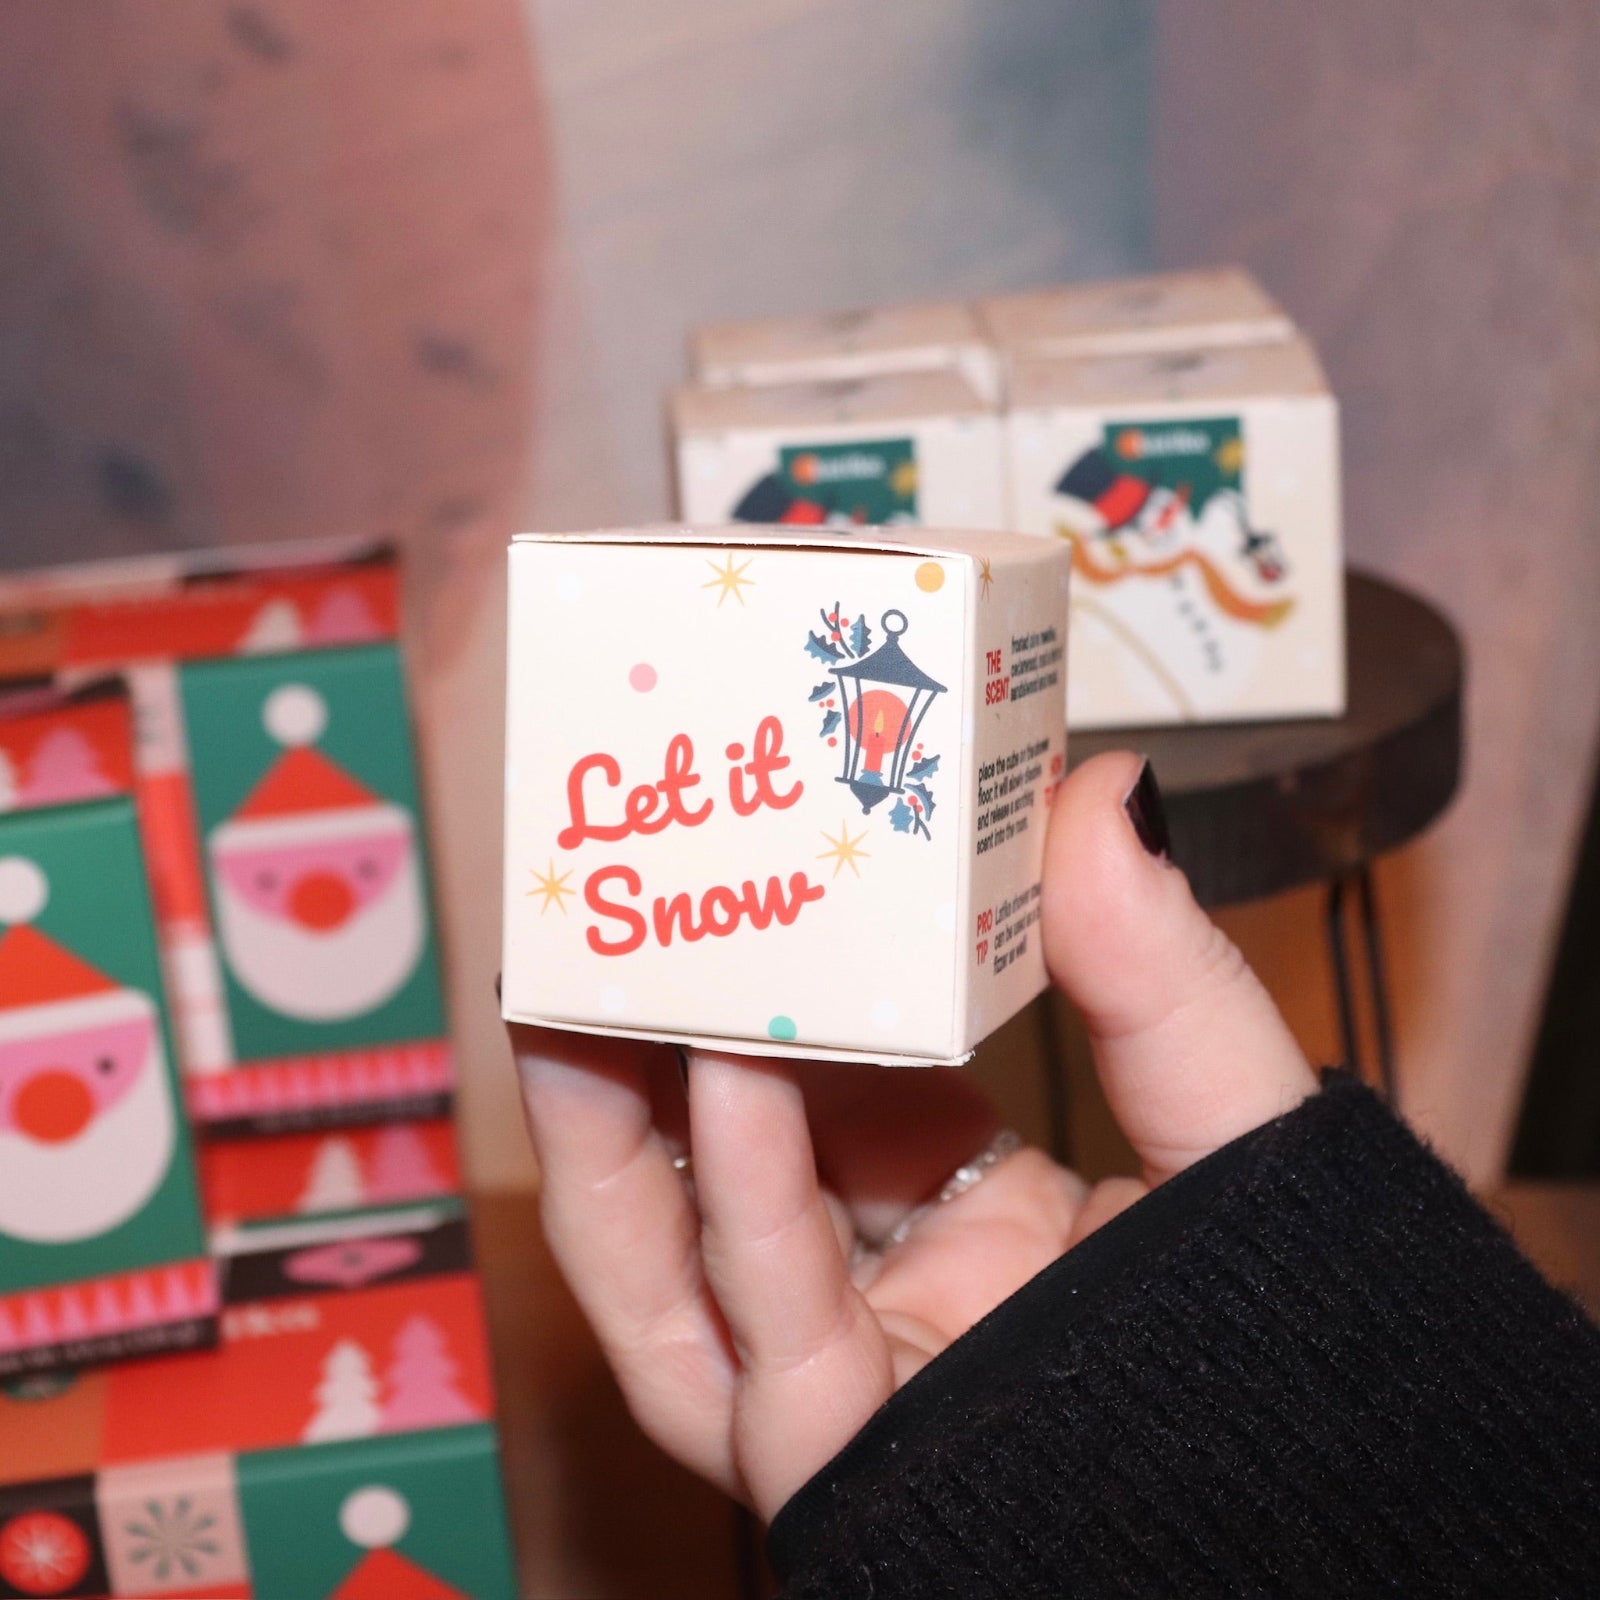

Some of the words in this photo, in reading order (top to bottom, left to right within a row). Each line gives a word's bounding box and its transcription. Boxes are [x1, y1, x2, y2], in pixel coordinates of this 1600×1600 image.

[986, 649, 1001, 676] THE
[985, 676, 1010, 706] SCENT
[557, 734, 713, 850] Let
[726, 716, 803, 816] it
[978, 761, 995, 787] place
[996, 755, 1005, 775] the
[978, 808, 990, 831] and
[977, 832, 994, 855] scent
[584, 865, 824, 956] Snow
[977, 908, 993, 937] PRO
[976, 939, 988, 966] TIP
